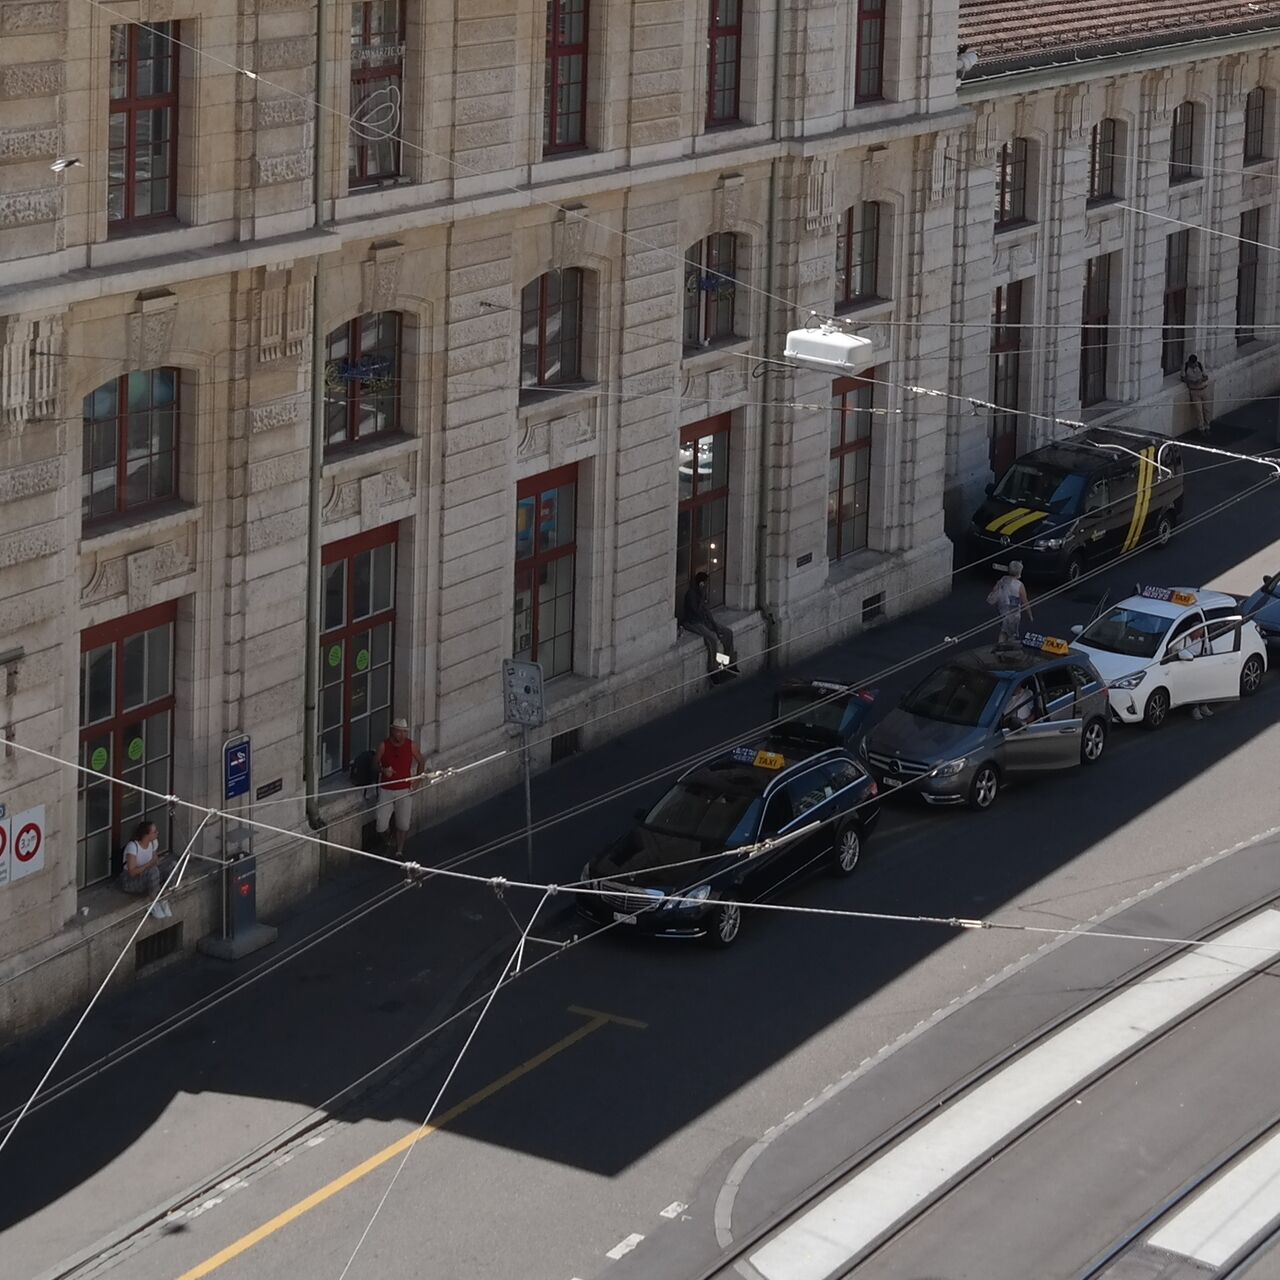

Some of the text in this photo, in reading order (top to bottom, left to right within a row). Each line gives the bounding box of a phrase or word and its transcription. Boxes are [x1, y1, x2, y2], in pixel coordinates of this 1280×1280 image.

[1175, 593, 1191, 603] TAXI
[1046, 639, 1066, 649] TAXI
[758, 757, 778, 767] TAXI
